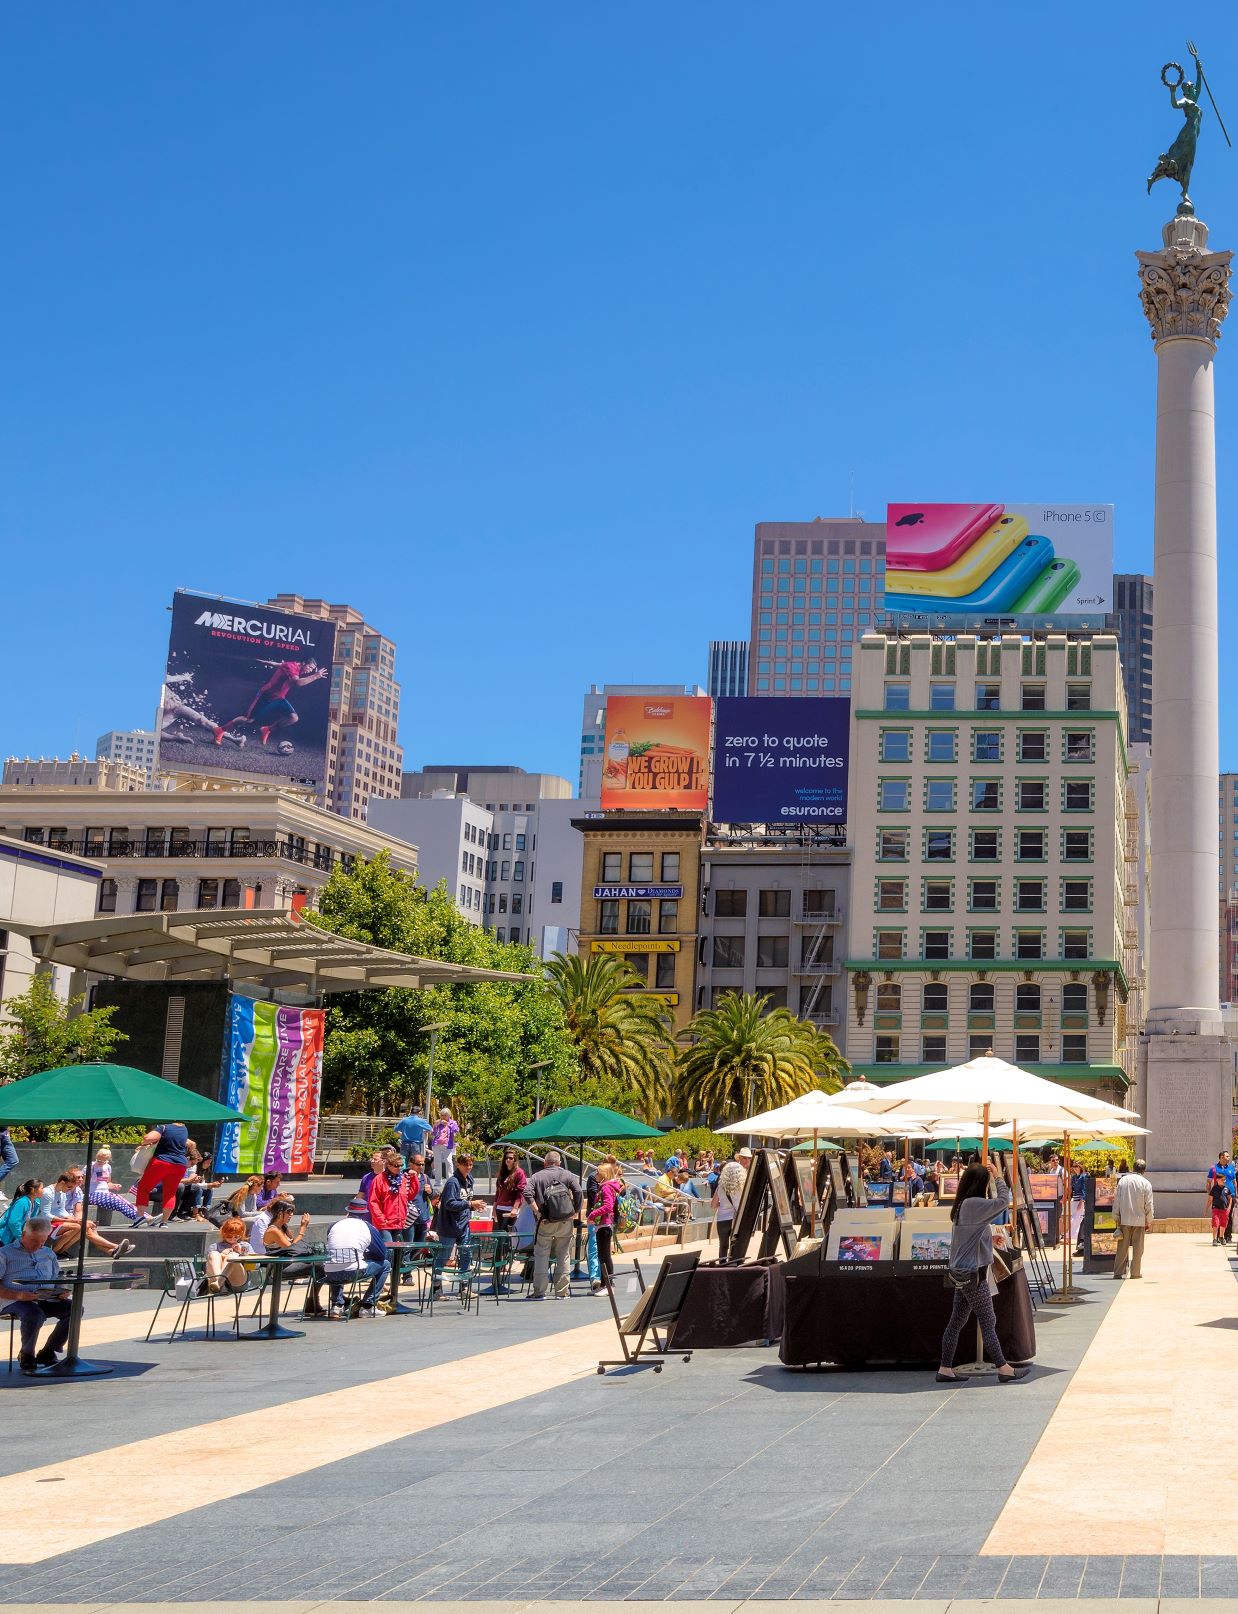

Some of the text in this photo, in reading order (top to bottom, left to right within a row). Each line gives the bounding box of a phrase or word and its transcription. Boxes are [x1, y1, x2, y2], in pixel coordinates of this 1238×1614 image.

[1043, 510, 1082, 522] iPhone
[1076, 597, 1096, 606] Sprint
[194, 611, 316, 647] MERCURIAL
[211, 630, 261, 644] REVOLUTION
[276, 642, 300, 651] SPEED
[724, 733, 829, 751] zero to quote
[628, 756, 649, 773] WE
[651, 756, 691, 773] GROW
[725, 753, 740, 767] in
[779, 753, 844, 768] minutes
[627, 772, 653, 790] YOU
[655, 772, 689, 790] GULP
[780, 806, 843, 816] esurance
[595, 888, 636, 897] JAHAN
[267, 1013, 289, 1166] UNION SQUARE LIVE
[293, 1017, 313, 1165] UNION SQUARE LIVE
[221, 1122, 232, 1164] UNIO
